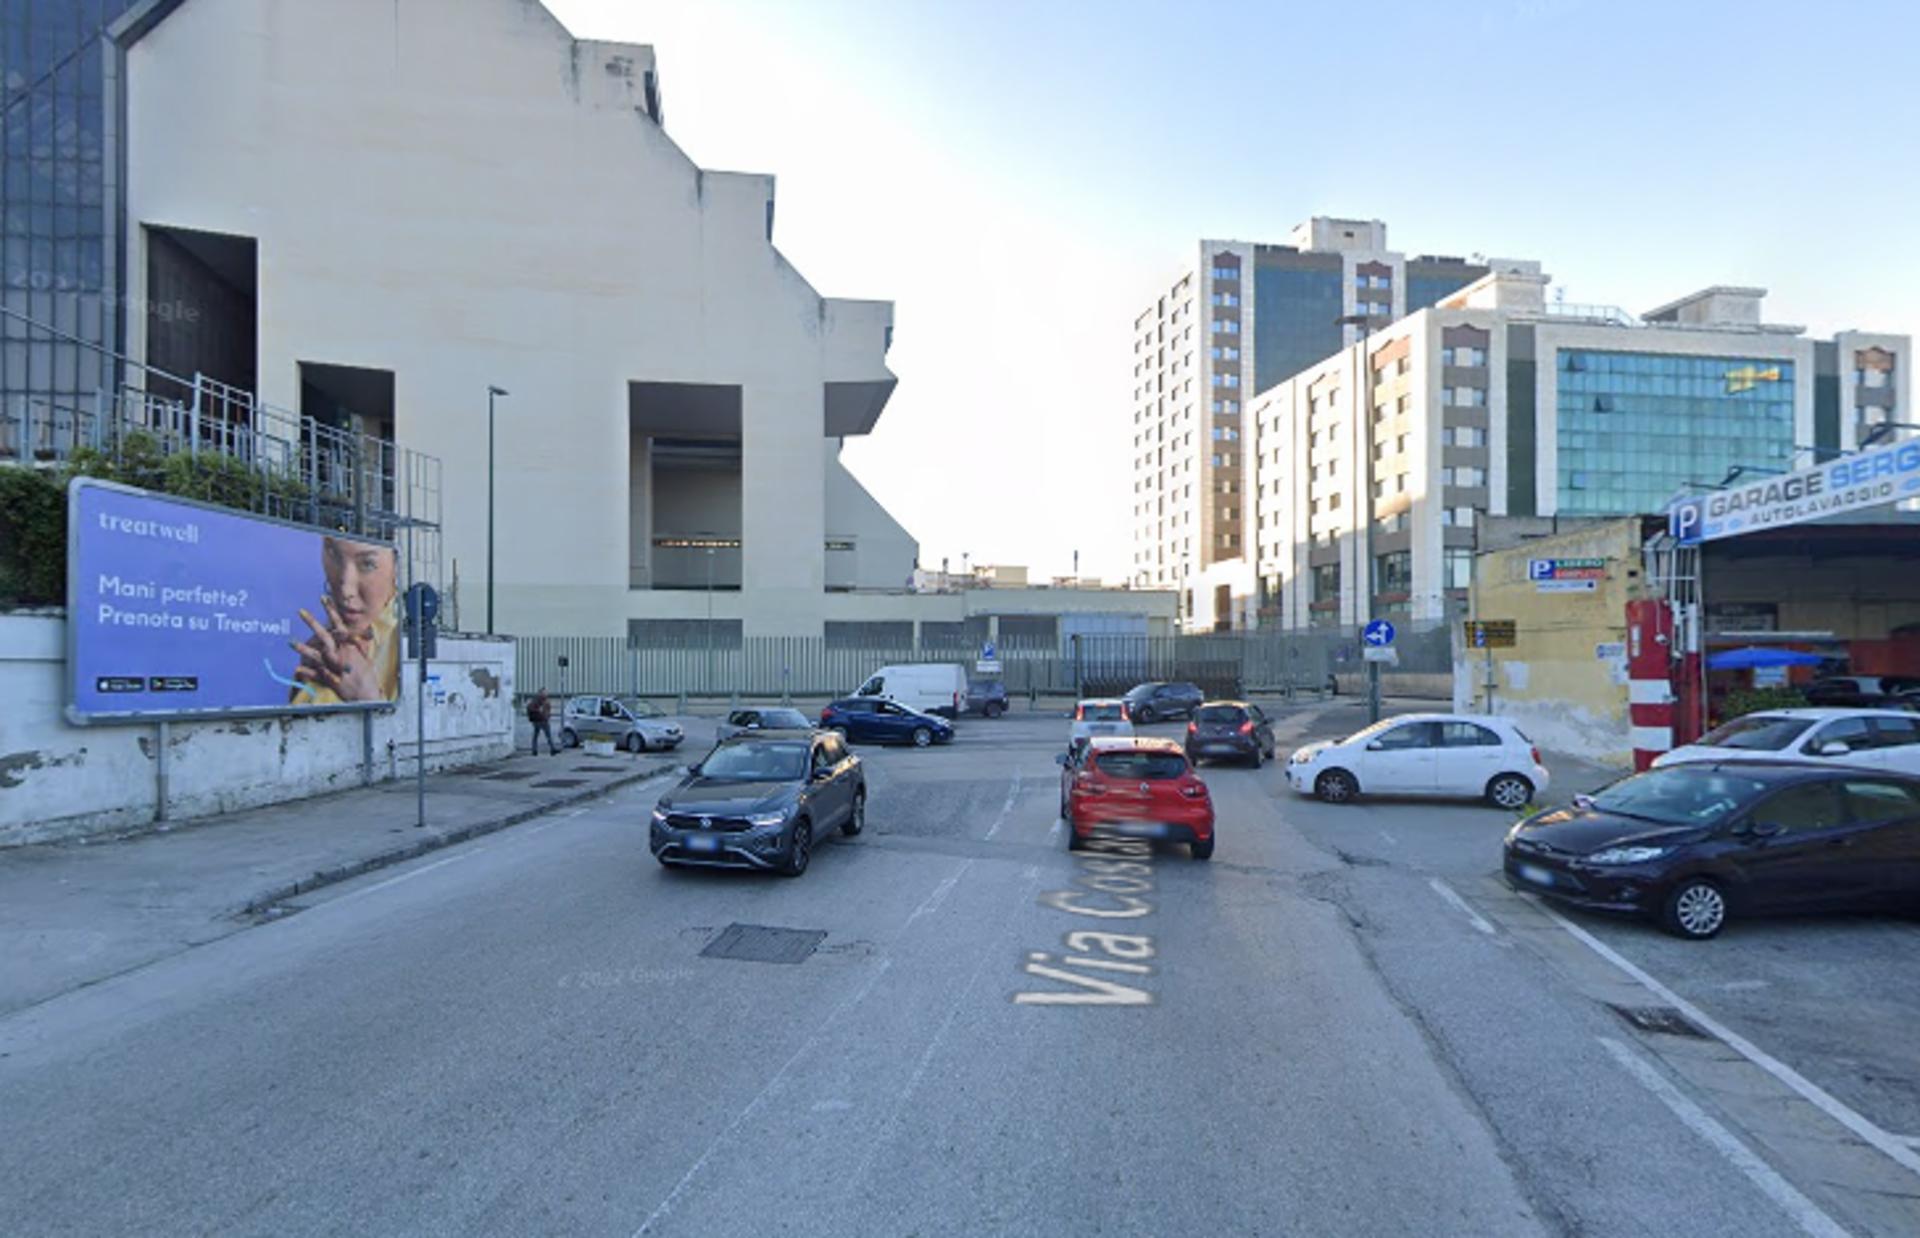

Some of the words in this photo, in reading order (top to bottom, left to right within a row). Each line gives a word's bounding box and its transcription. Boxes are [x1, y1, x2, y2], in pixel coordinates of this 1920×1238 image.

[1709, 471, 1823, 517] GARAGE
[1750, 482, 1893, 524] AUTOLAVAGGIO
[99, 511, 199, 544] treatwell
[99, 573, 155, 599] Mani
[161, 584, 248, 608] perfette?
[99, 603, 183, 629] Prenota
[188, 615, 209, 631] su
[214, 612, 291, 636] Treatwell
